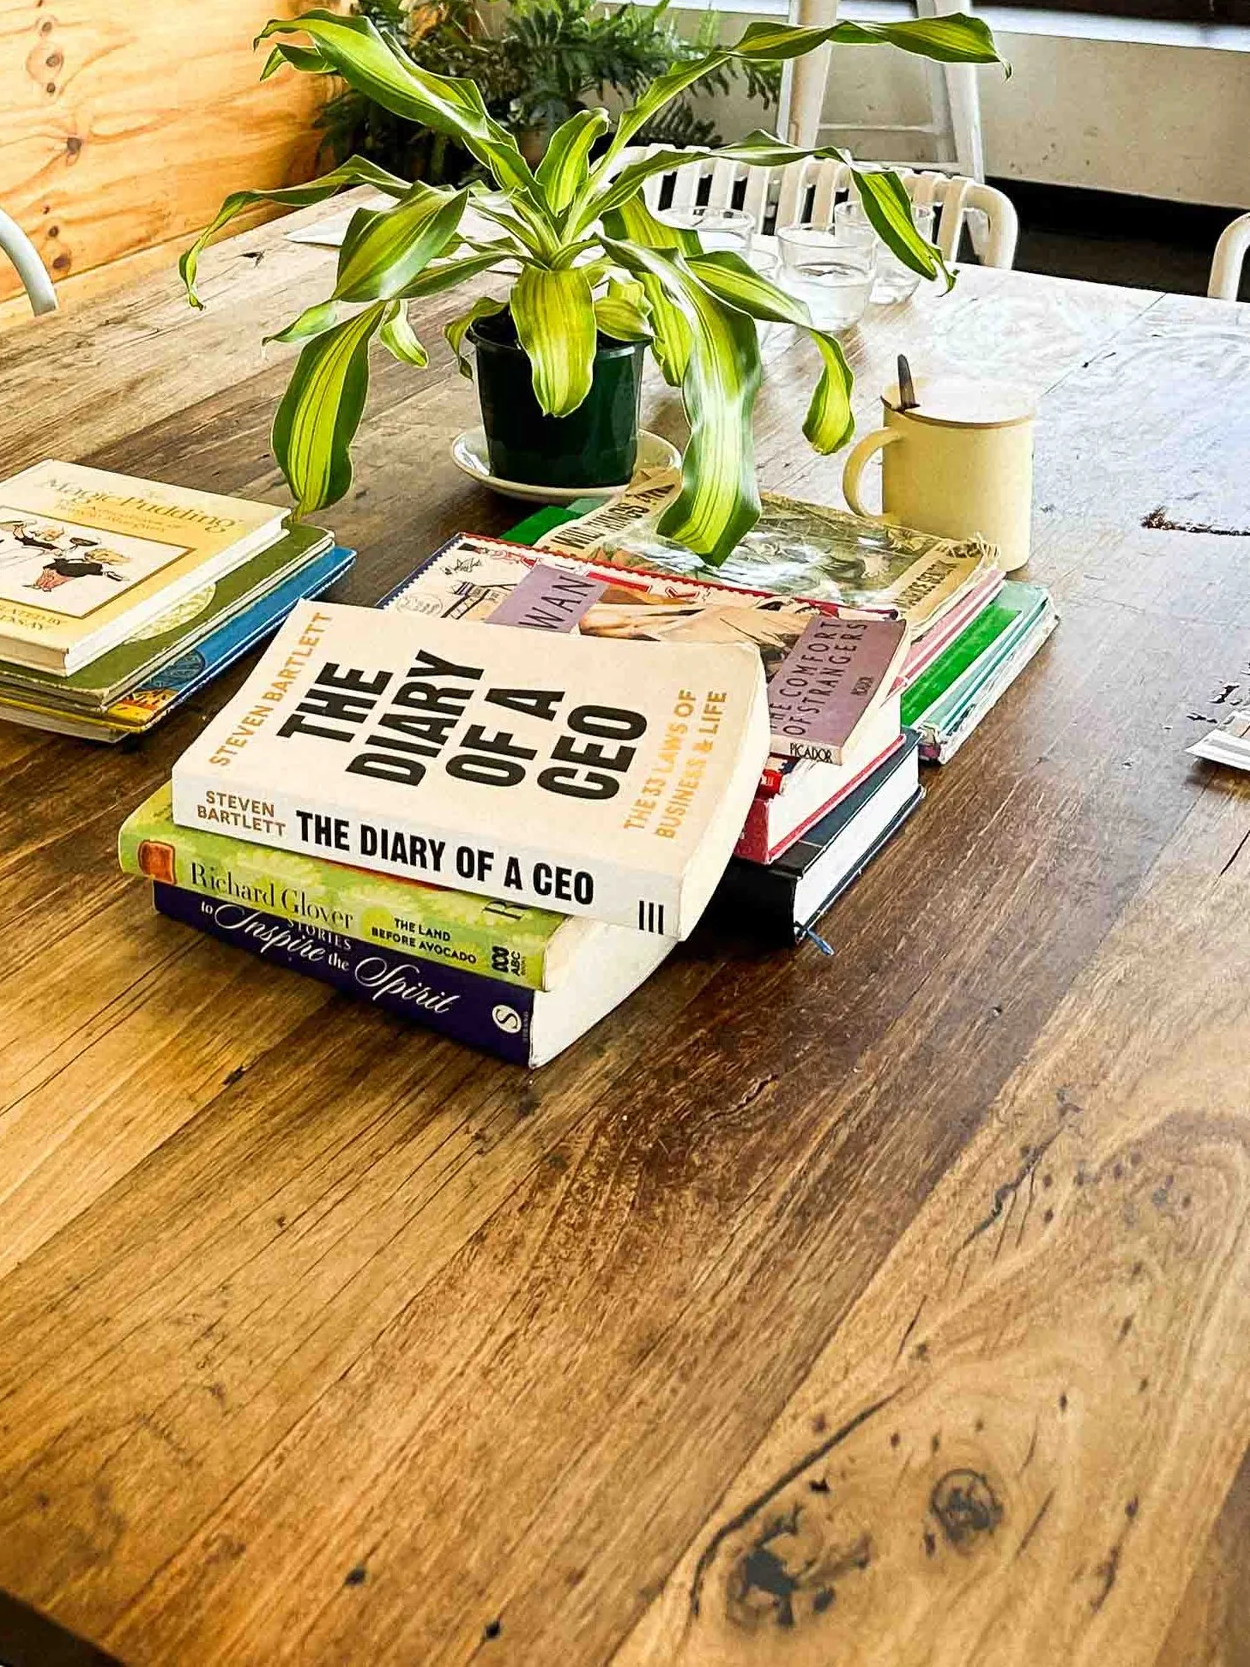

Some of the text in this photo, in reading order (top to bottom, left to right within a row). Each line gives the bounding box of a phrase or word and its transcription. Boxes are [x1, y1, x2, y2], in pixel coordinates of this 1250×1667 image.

[120, 495, 237, 534] Pudding
[209, 612, 332, 766] STEVEN BARTLETT
[779, 621, 841, 698] COMFORT
[797, 623, 868, 715] STRANGERS
[276, 662, 394, 742] THE
[345, 649, 484, 786] DIARY
[445, 687, 565, 787] OF A
[536, 705, 647, 800] CEO
[624, 796, 650, 830] THE
[653, 722, 688, 775] LAWS
[673, 689, 696, 718] OF
[655, 757, 707, 839] BUSINESS
[699, 690, 727, 736] LIFE
[789, 742, 833, 763] PICADOR
[197, 804, 287, 837] BARTLETT
[205, 789, 275, 818] STEVEN
[190, 861, 354, 930] Richard Glover
[296, 809, 594, 905] THE DIARY OF A CEO
[201, 900, 461, 1014] to Inspire the Spirit
[371, 926, 477, 965] BEFORE AVOCADO
[393, 917, 451, 942] THE LAND
[508, 950, 521, 978] ABC
